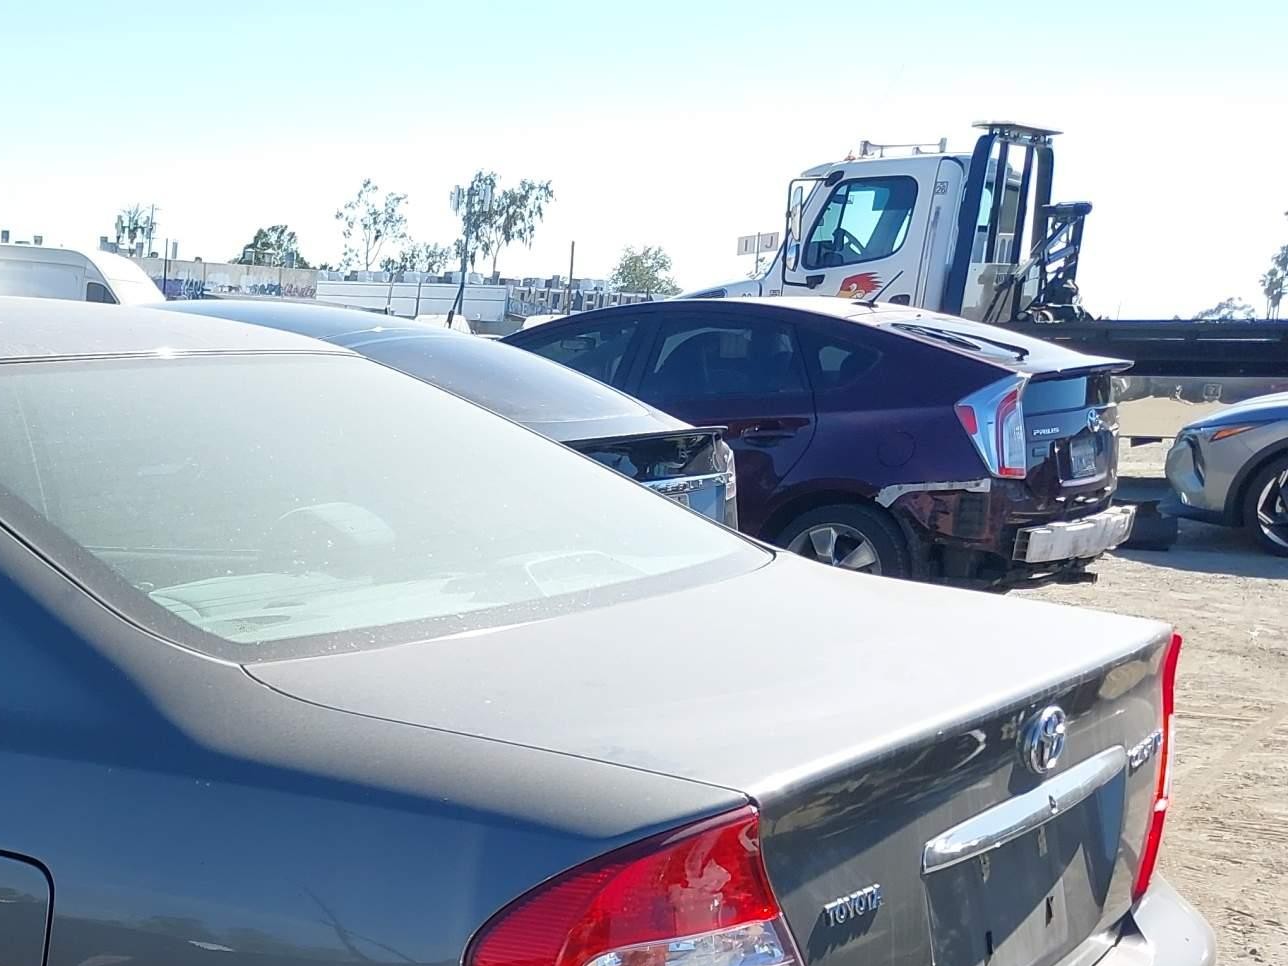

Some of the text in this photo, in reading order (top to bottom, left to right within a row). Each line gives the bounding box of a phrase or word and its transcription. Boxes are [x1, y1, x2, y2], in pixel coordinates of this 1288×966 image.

[765, 235, 774, 249] J
[1033, 427, 1060, 436] PRIUS
[824, 883, 884, 927] TOYOTA
